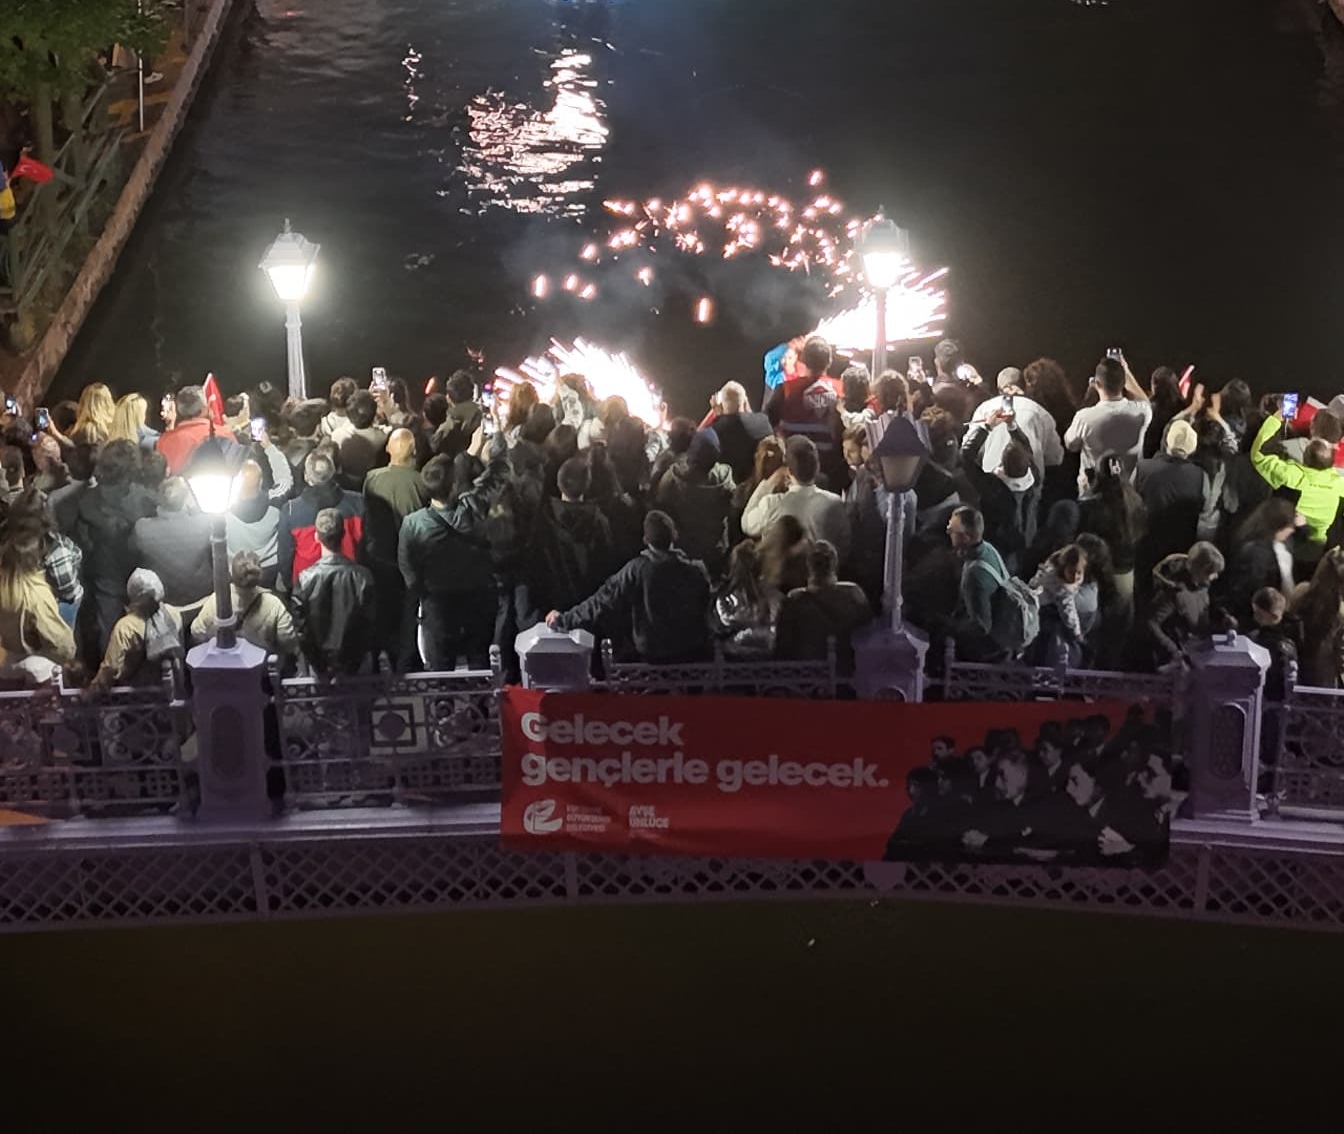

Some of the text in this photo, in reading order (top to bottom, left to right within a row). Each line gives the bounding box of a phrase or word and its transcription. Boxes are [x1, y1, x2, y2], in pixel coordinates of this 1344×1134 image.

[520, 712, 684, 747] Gelecek
[520, 751, 890, 793] gençlerle gelecek.
